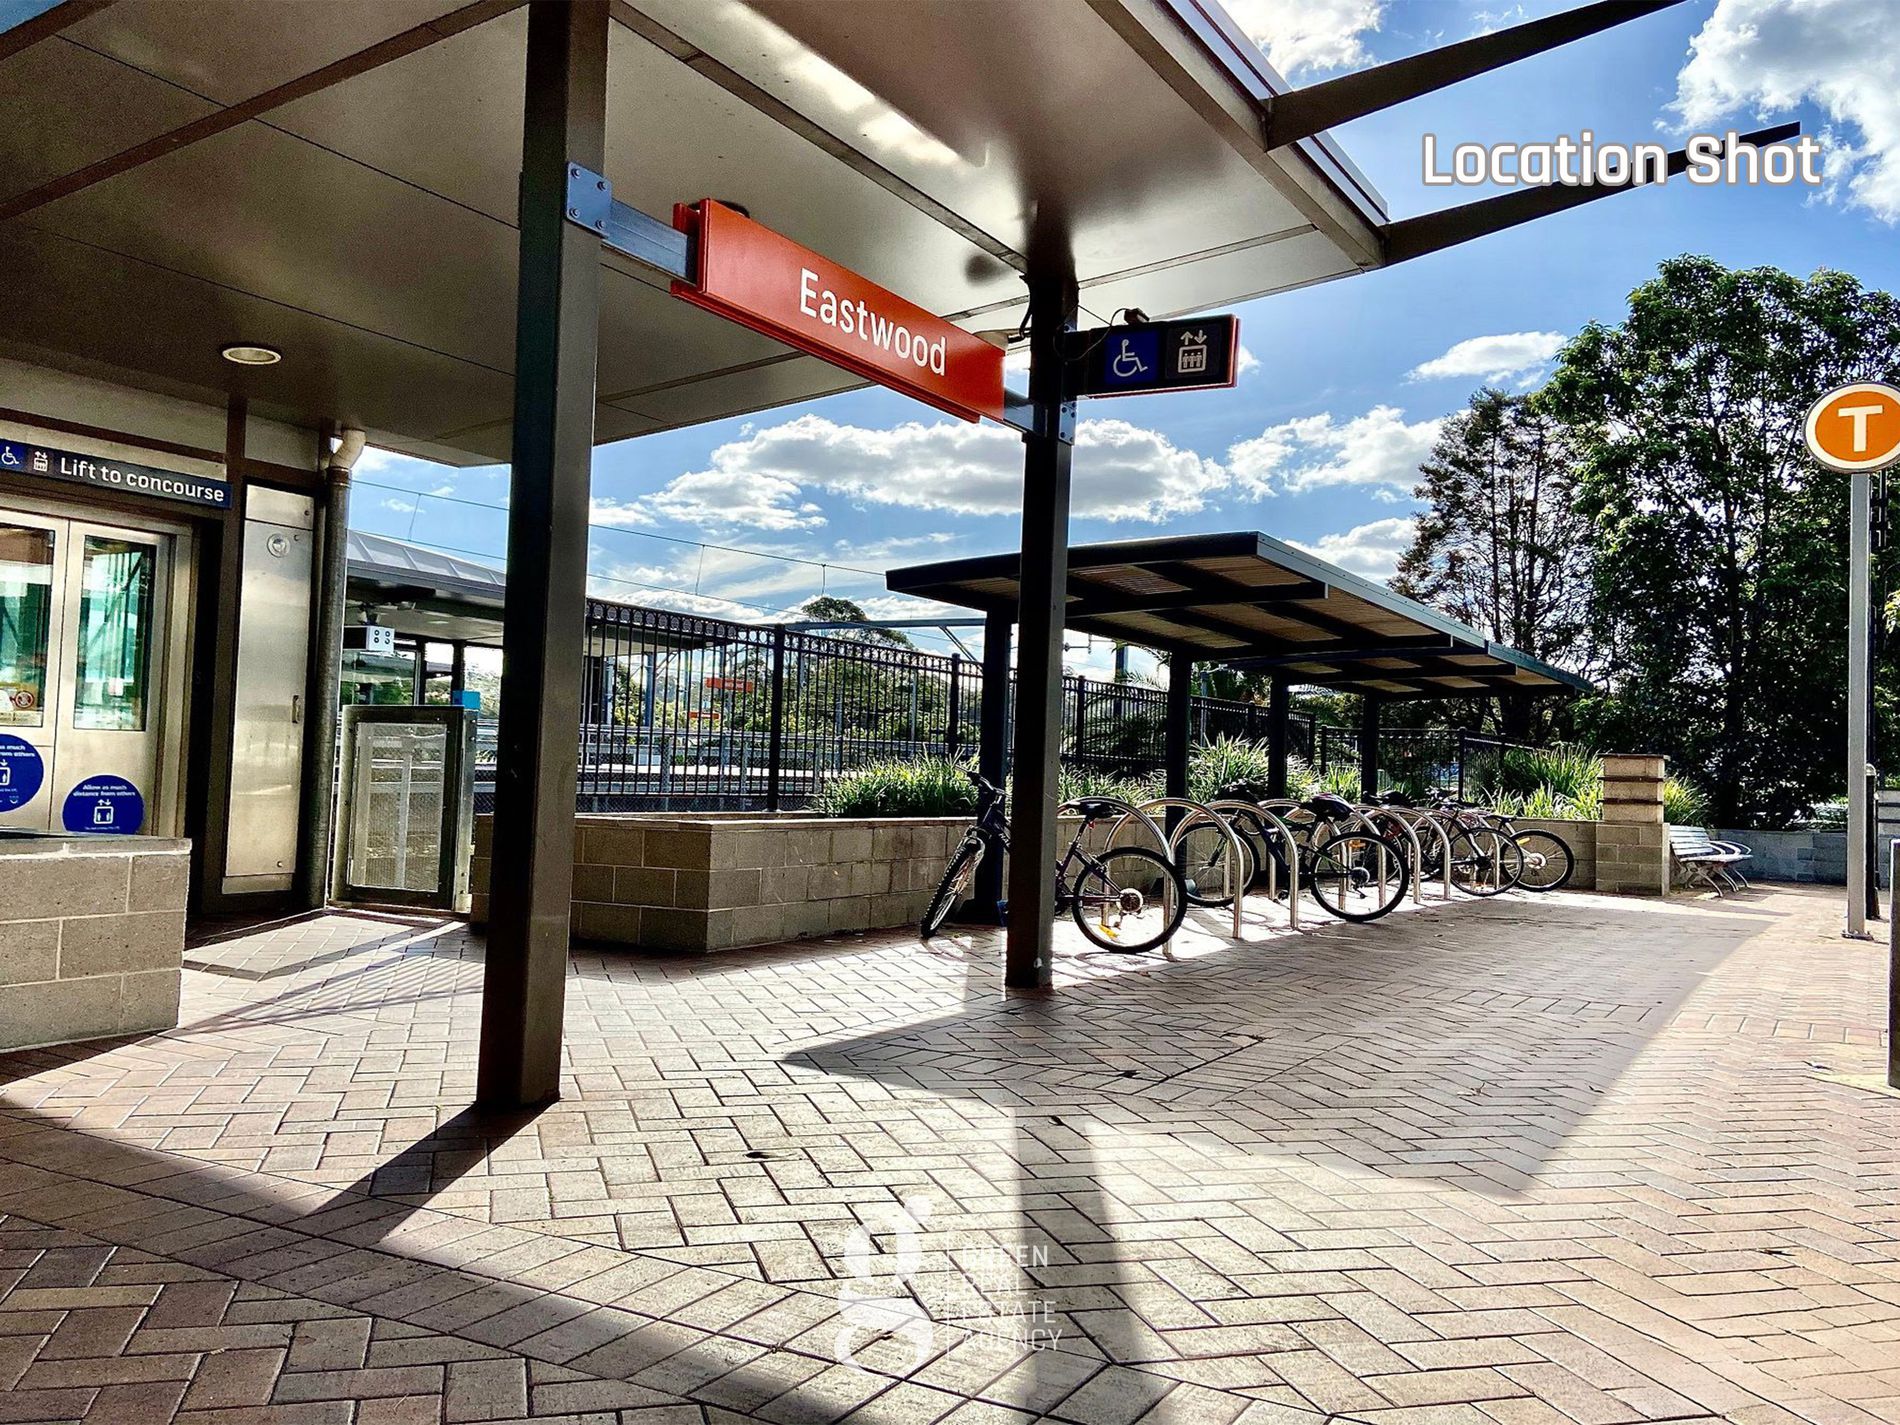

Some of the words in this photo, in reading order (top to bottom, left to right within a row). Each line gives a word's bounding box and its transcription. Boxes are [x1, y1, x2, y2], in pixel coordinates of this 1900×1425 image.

[800, 267, 946, 376] Eastwood
[1837, 404, 1883, 452] T
[60, 457, 96, 479] Lift
[100, 464, 121, 484] to
[126, 473, 225, 502] concourse
